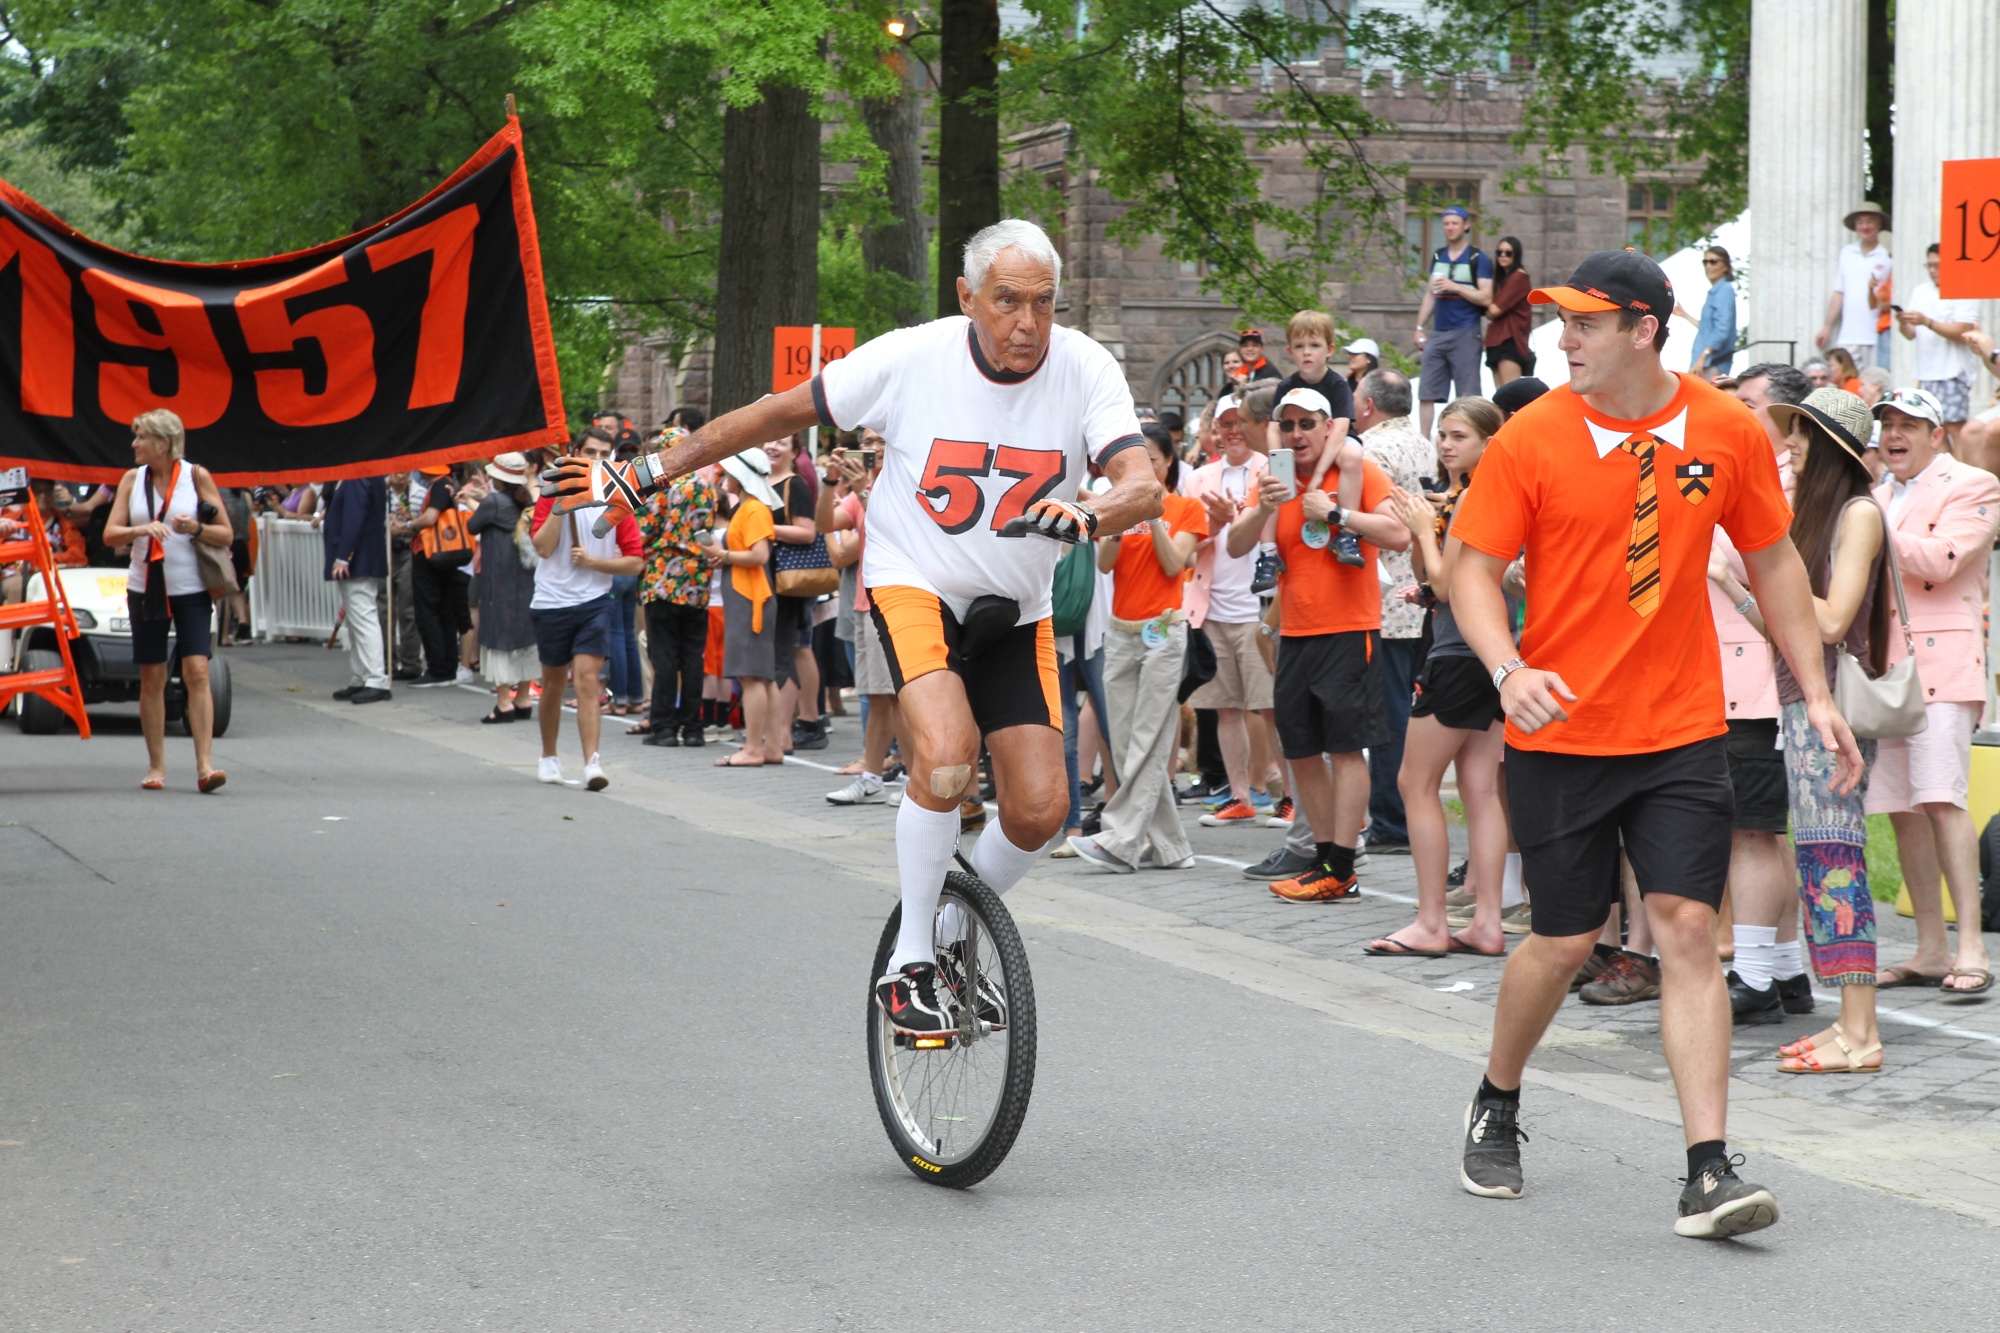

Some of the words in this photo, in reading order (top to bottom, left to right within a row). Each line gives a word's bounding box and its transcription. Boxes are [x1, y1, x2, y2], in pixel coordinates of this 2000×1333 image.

[0, 203, 480, 429] 1957
[915, 438, 1066, 537] 57
[911, 1156, 943, 1172] MAXXIS
